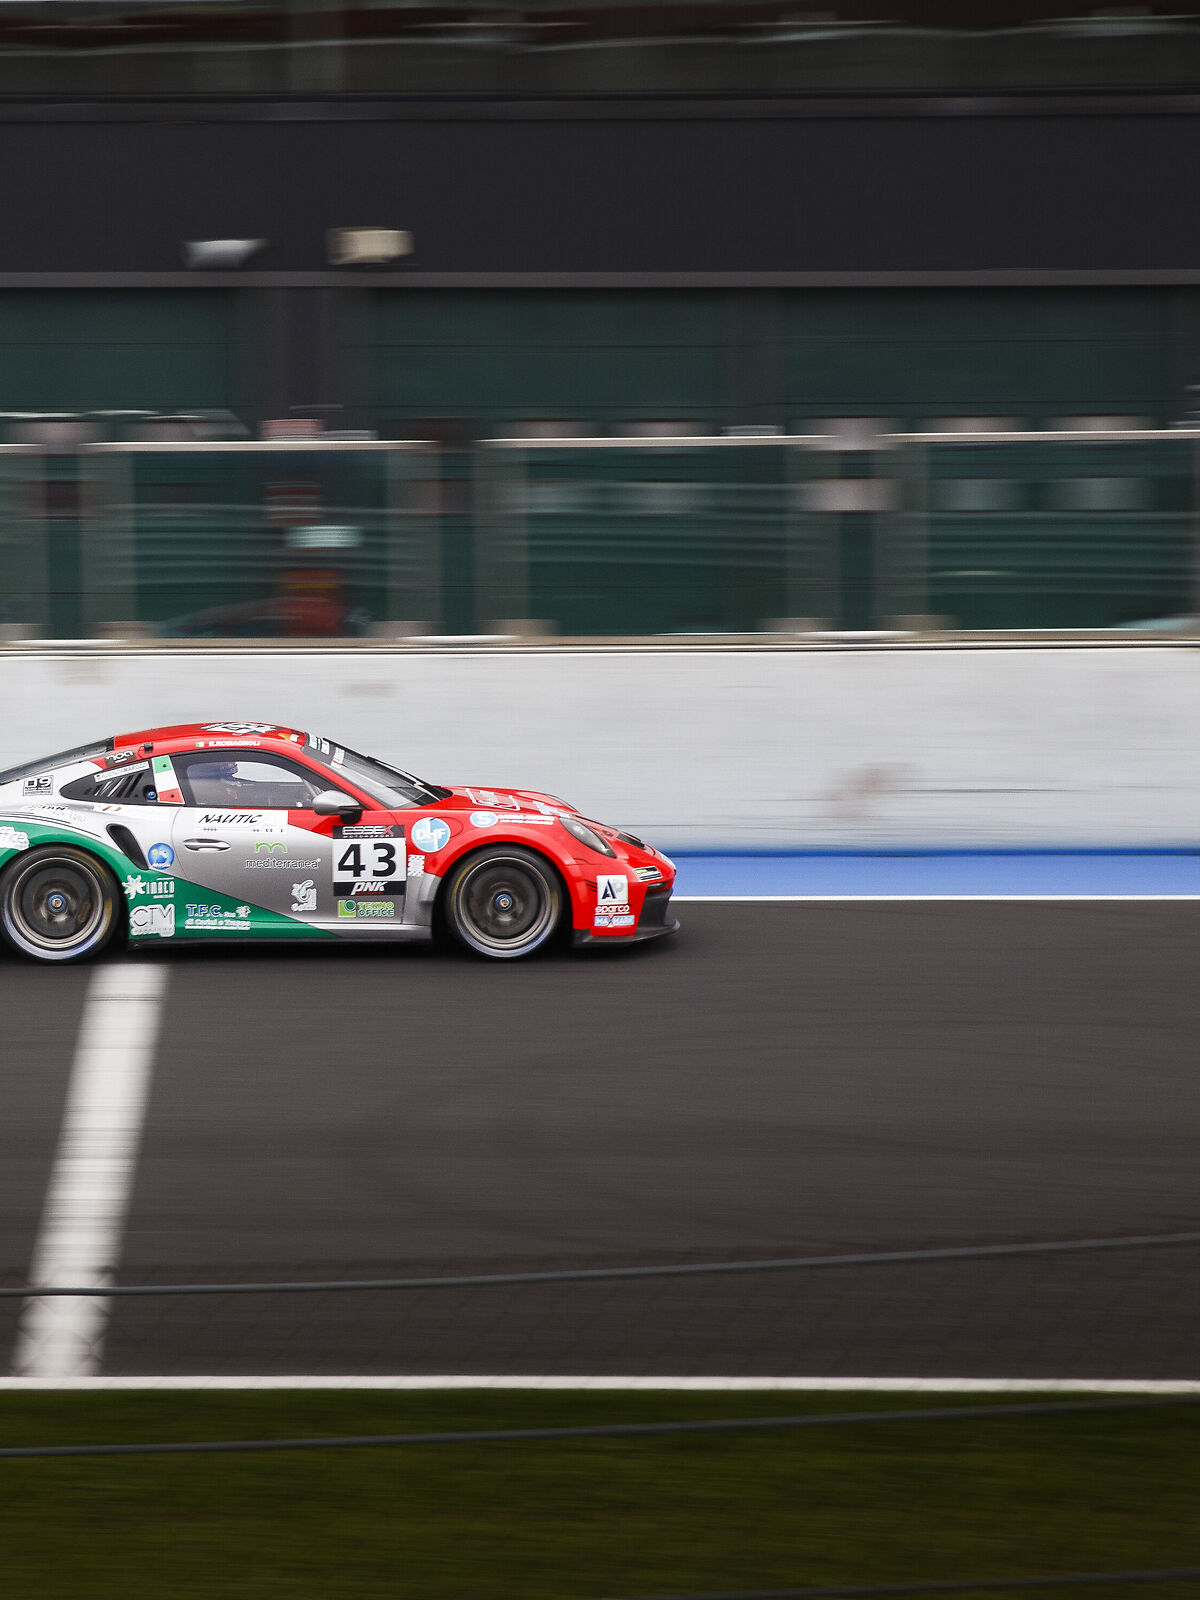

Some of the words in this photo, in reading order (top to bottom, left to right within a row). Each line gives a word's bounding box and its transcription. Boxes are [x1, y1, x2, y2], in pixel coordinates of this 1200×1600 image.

[338, 843, 396, 877] 43
[358, 909, 395, 917] OFFICE
[595, 905, 630, 915] sparco
